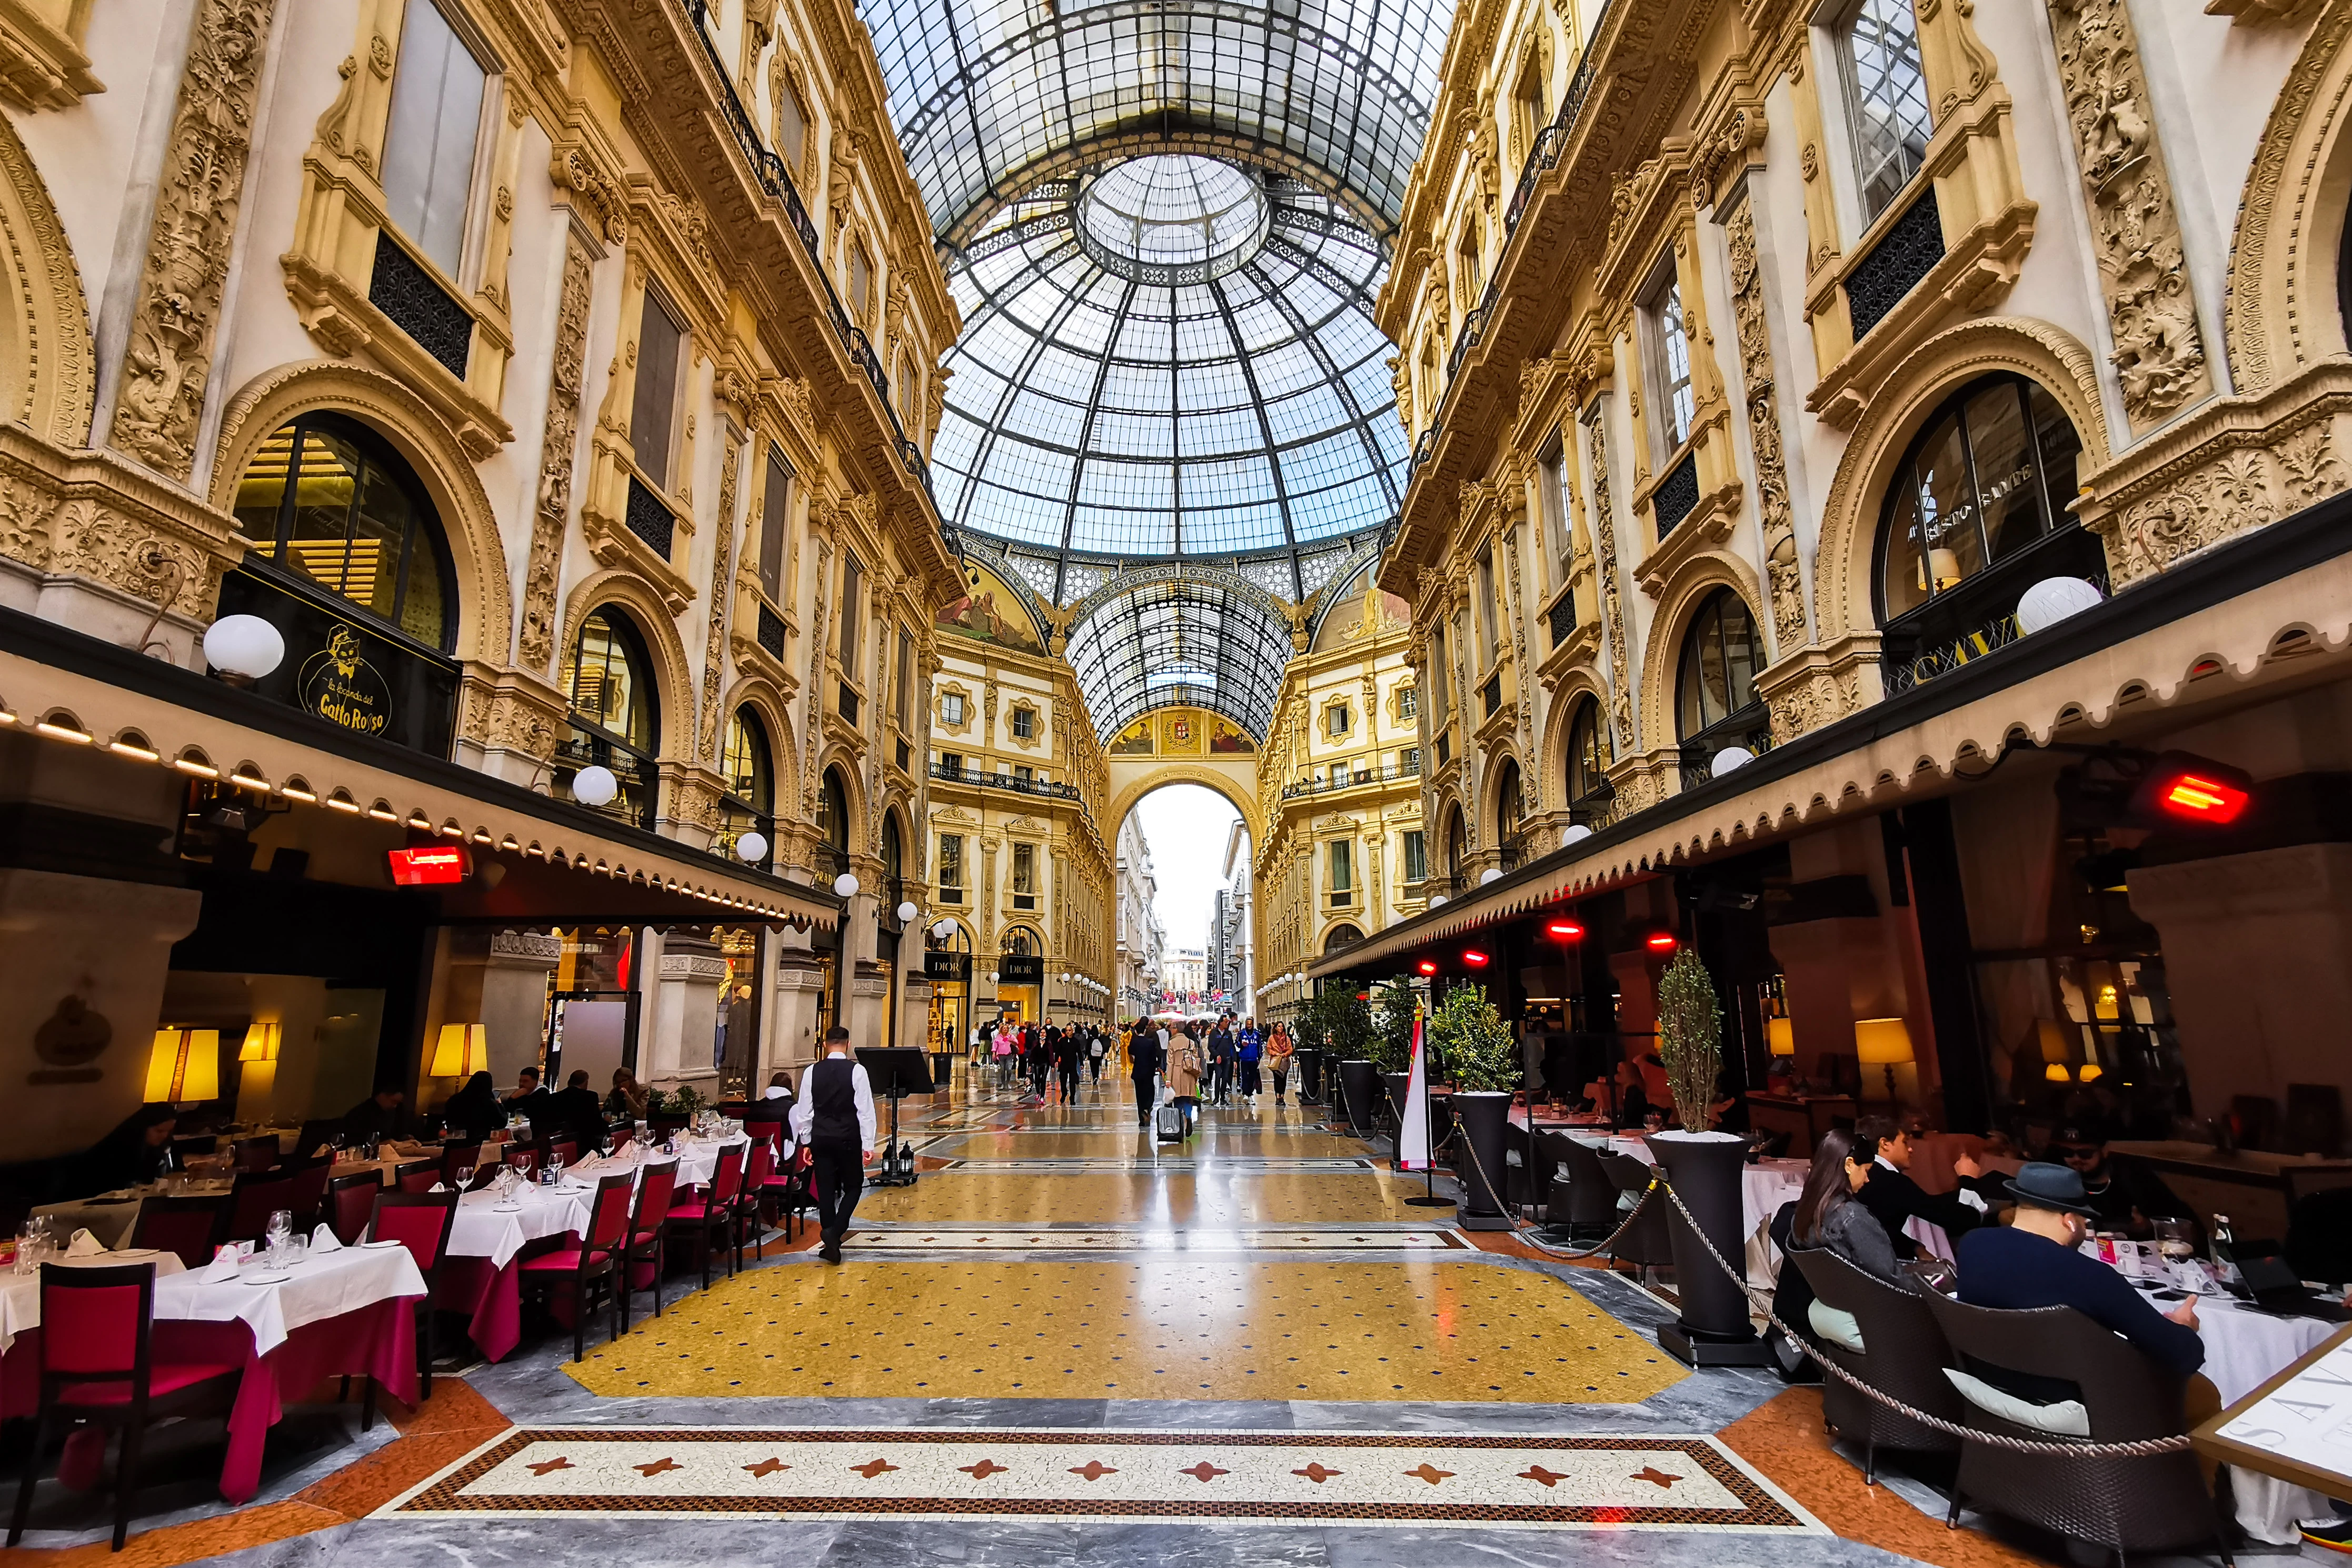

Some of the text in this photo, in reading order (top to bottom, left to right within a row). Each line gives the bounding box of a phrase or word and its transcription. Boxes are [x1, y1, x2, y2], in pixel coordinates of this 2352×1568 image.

[320, 694, 384, 731] Gatto Rosso
[815, 870, 835, 885] PRAD
[935, 962, 960, 972] DIOR
[1010, 964, 1032, 975] DIOR
[2227, 1346, 2352, 1448] SAV
